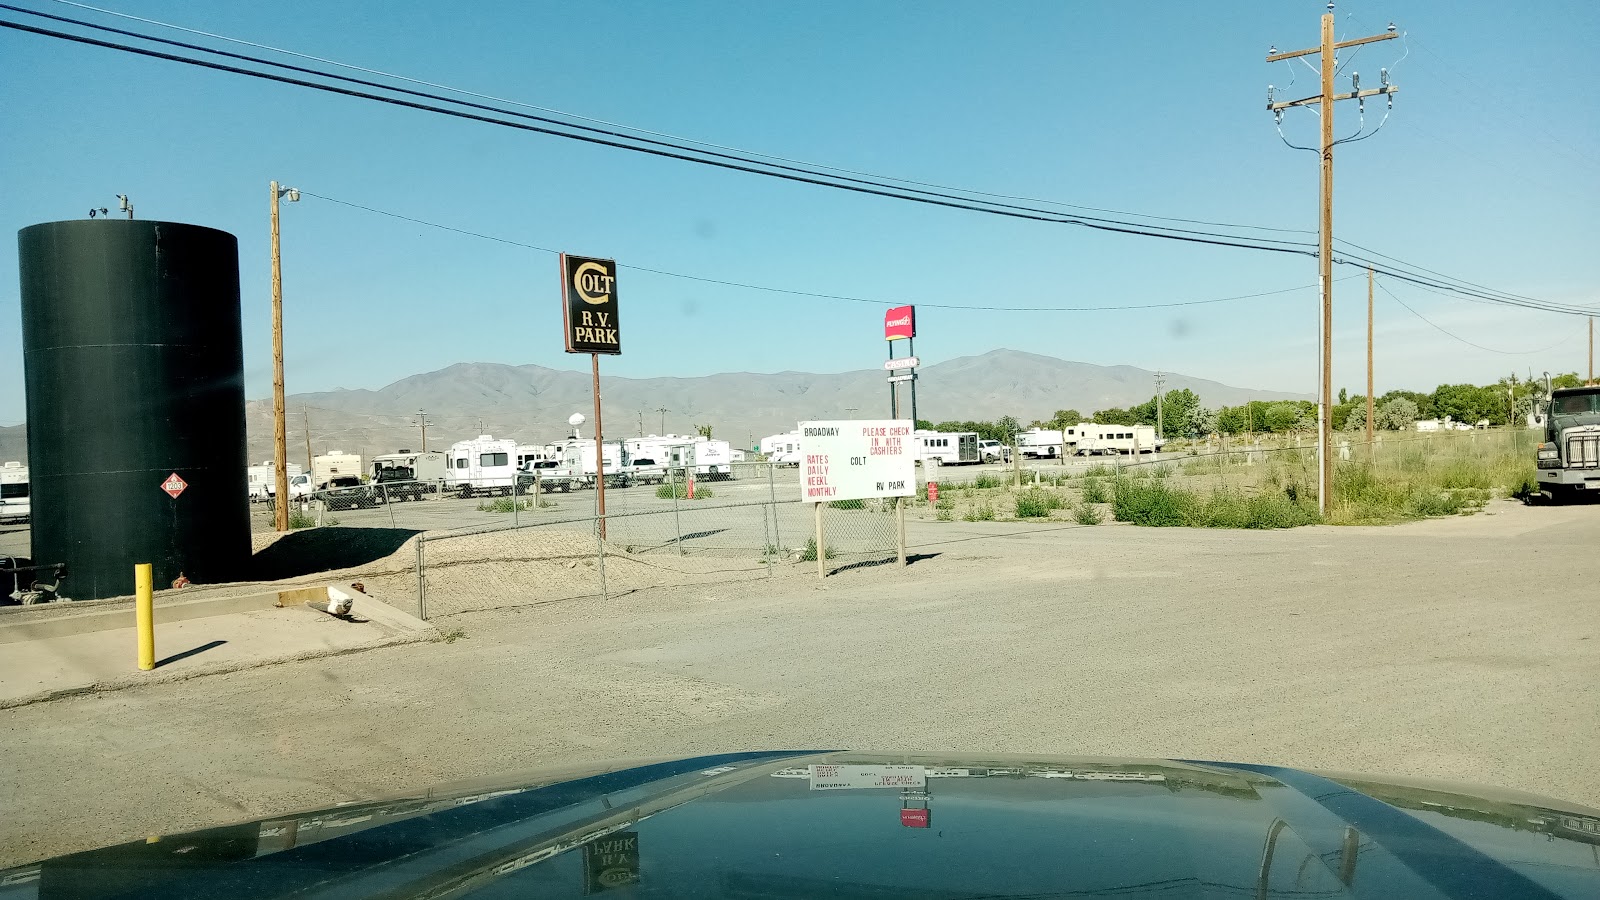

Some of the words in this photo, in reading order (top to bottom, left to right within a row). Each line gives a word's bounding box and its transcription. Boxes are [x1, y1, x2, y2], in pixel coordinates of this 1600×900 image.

[574, 262, 614, 304] COLT
[582, 311, 611, 328] R.V.
[575, 327, 618, 344] PARK
[885, 357, 916, 370] CASINO
[804, 427, 840, 437] BROADWAY
[862, 427, 887, 437] PLEASE
[889, 426, 910, 436] CHECK
[871, 437, 879, 447] IN
[885, 437, 901, 447] WITH
[870, 446, 903, 456] CASHIERS
[807, 454, 829, 465] RATES
[850, 456, 867, 466] COLT
[807, 465, 829, 476] DAILY
[167, 482, 182, 490] 1203
[876, 481, 885, 491] RV
[888, 480, 905, 490] PARK
[807, 486, 837, 498] MONTHLY
